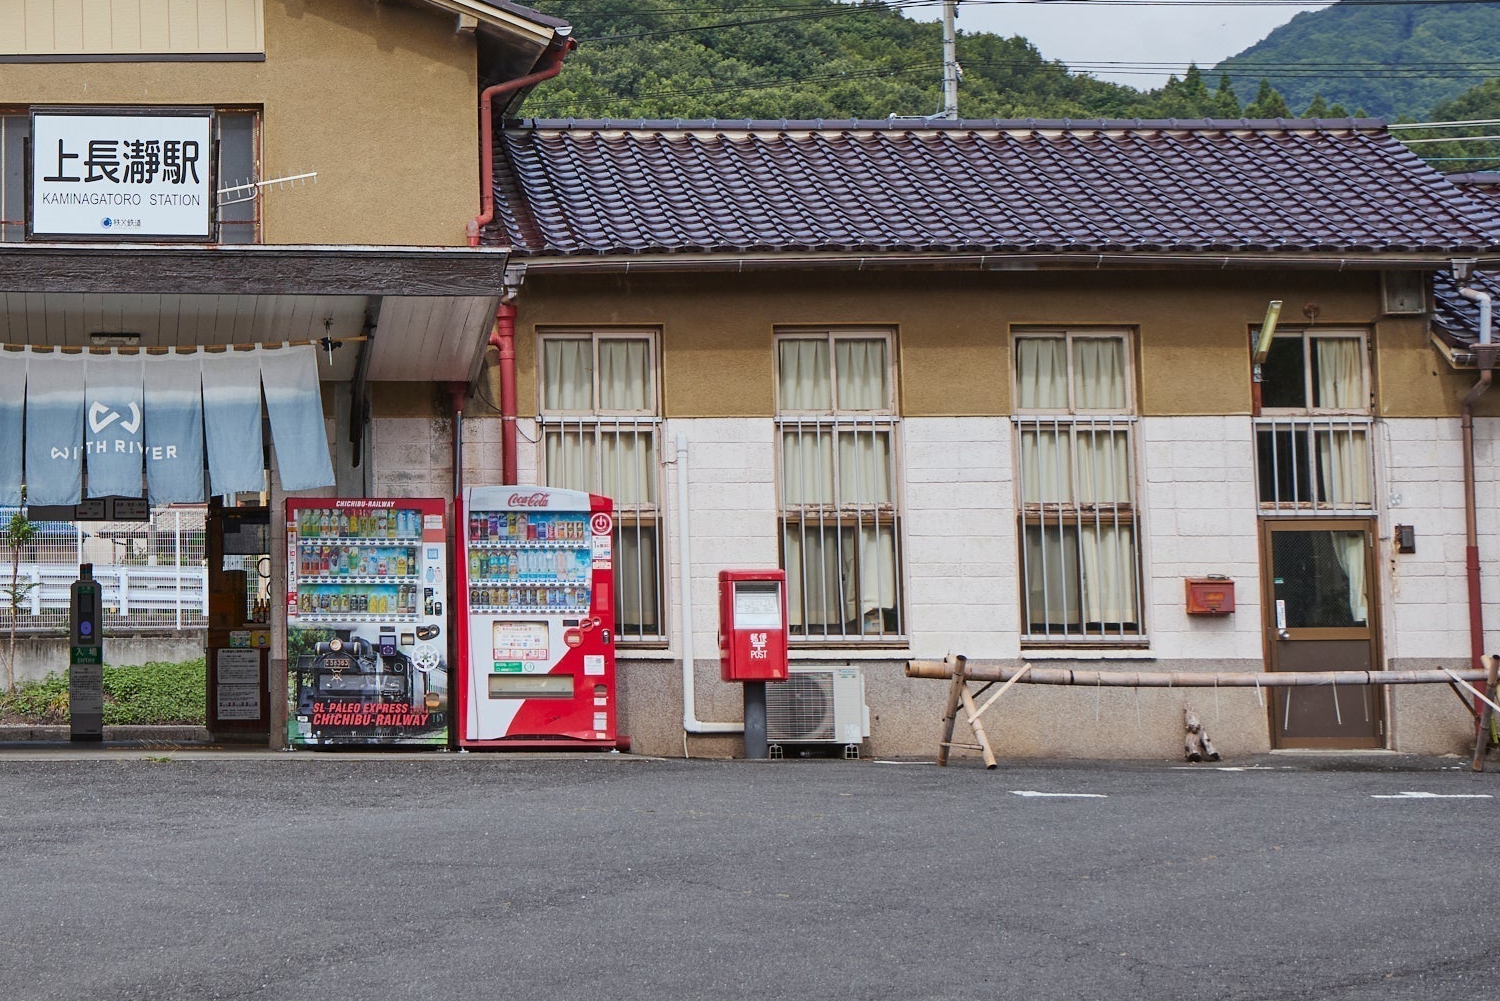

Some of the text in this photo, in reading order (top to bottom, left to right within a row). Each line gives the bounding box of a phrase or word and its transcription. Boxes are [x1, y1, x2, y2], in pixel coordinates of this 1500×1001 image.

[43, 138, 200, 184] 上長瀞駅
[42, 192, 201, 206] KAMINAGATORO STATION
[50, 439, 178, 460] WITH RIVER
[507, 492, 550, 507] Coca-Cola
[750, 649, 768, 659] POST
[313, 702, 409, 714] SL PALEO EXPRESS
[313, 713, 429, 726] CHICHIBU-RAILWAY
